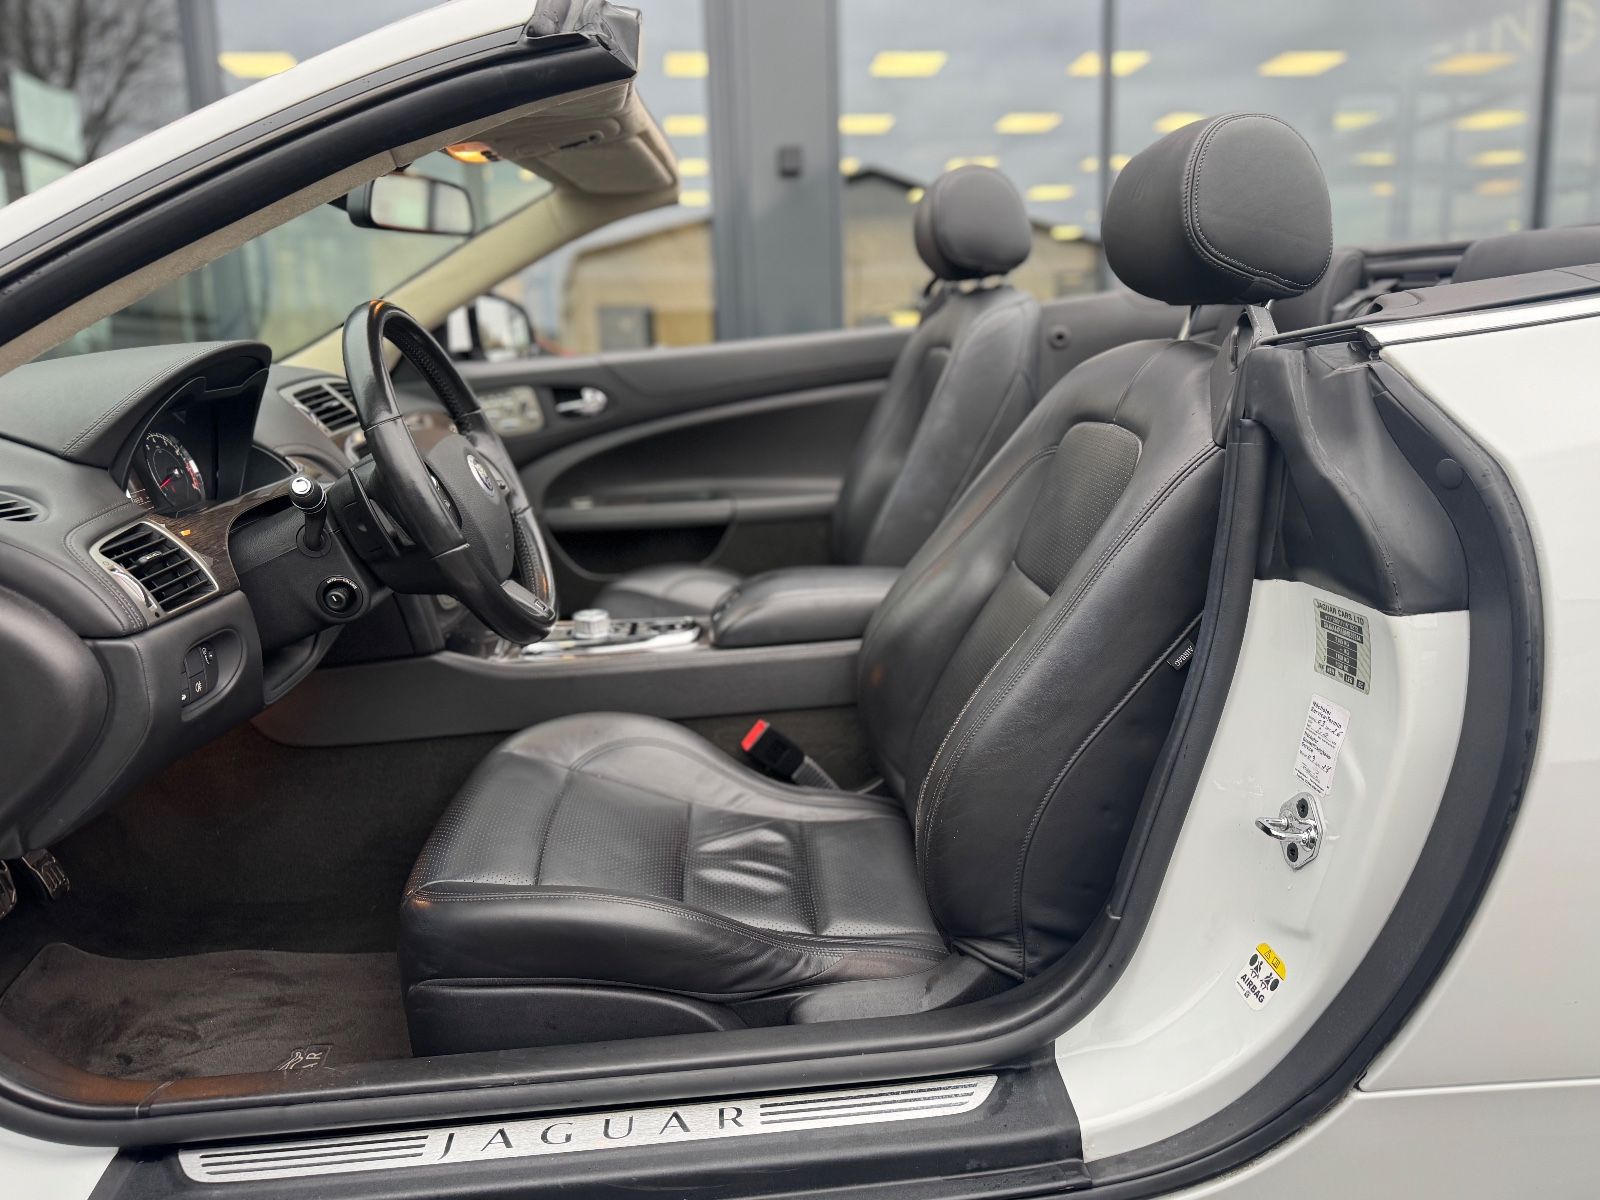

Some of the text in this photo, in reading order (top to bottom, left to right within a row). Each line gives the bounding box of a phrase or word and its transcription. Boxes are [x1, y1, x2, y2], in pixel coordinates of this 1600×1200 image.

[1316, 601, 1337, 615] JAGUAR
[1337, 609, 1353, 621] CARS
[1354, 615, 1365, 626] LTD
[1174, 646, 1194, 667] AIRBAG
[1240, 974, 1265, 1003] AIRBAG
[438, 1105, 746, 1161] JAGUAR
